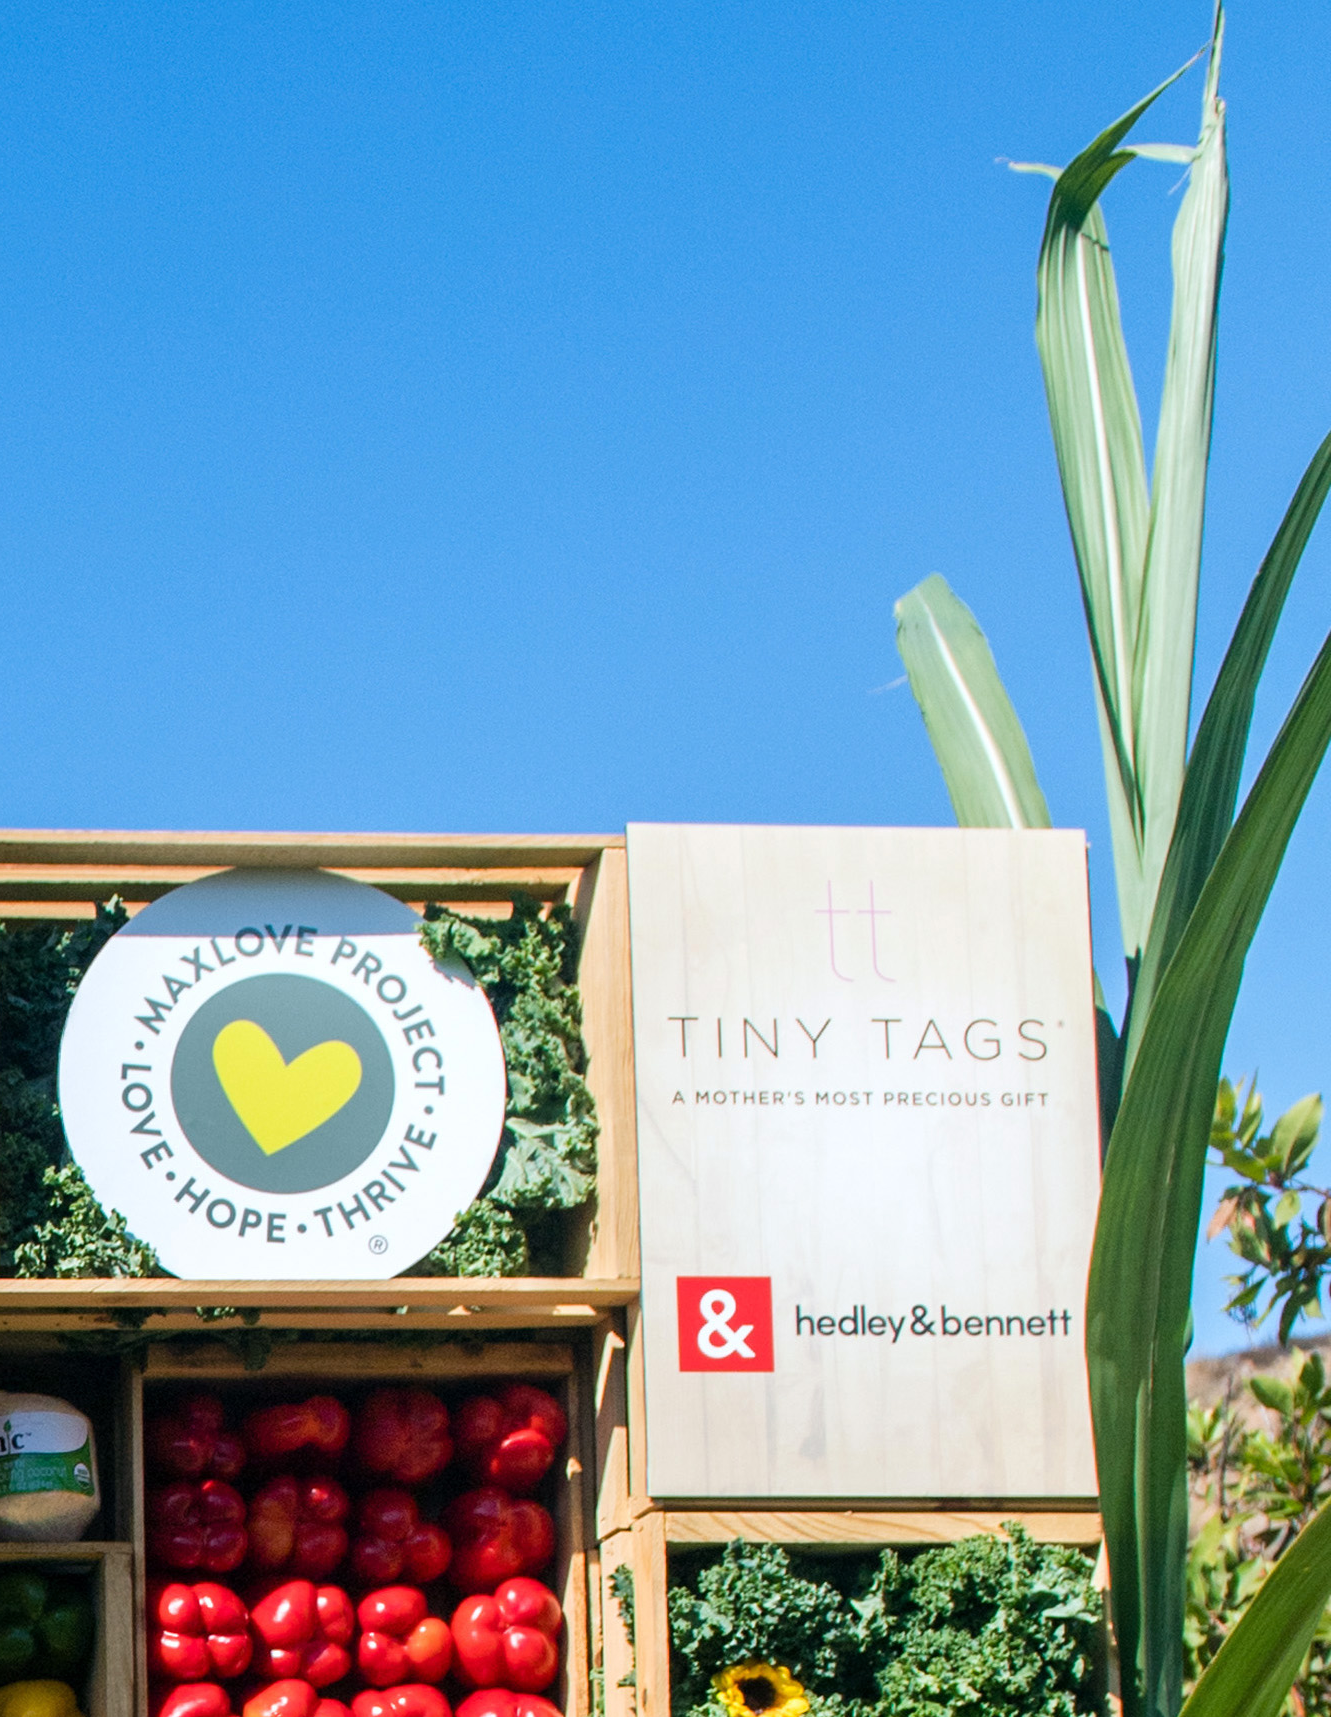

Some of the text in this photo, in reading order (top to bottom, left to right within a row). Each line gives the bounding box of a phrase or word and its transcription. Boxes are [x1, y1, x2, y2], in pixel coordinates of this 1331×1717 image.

[134, 924, 445, 1096] MAXLOVE PROJECT
[667, 1016, 832, 1059] TINY
[672, 1090, 1050, 1107] A MOTHER'S MOST PRECIOUS GIFT
[122, 1062, 175, 1169] LOVE
[174, 1178, 287, 1244] HOPE
[314, 1123, 438, 1238] THRIVE
